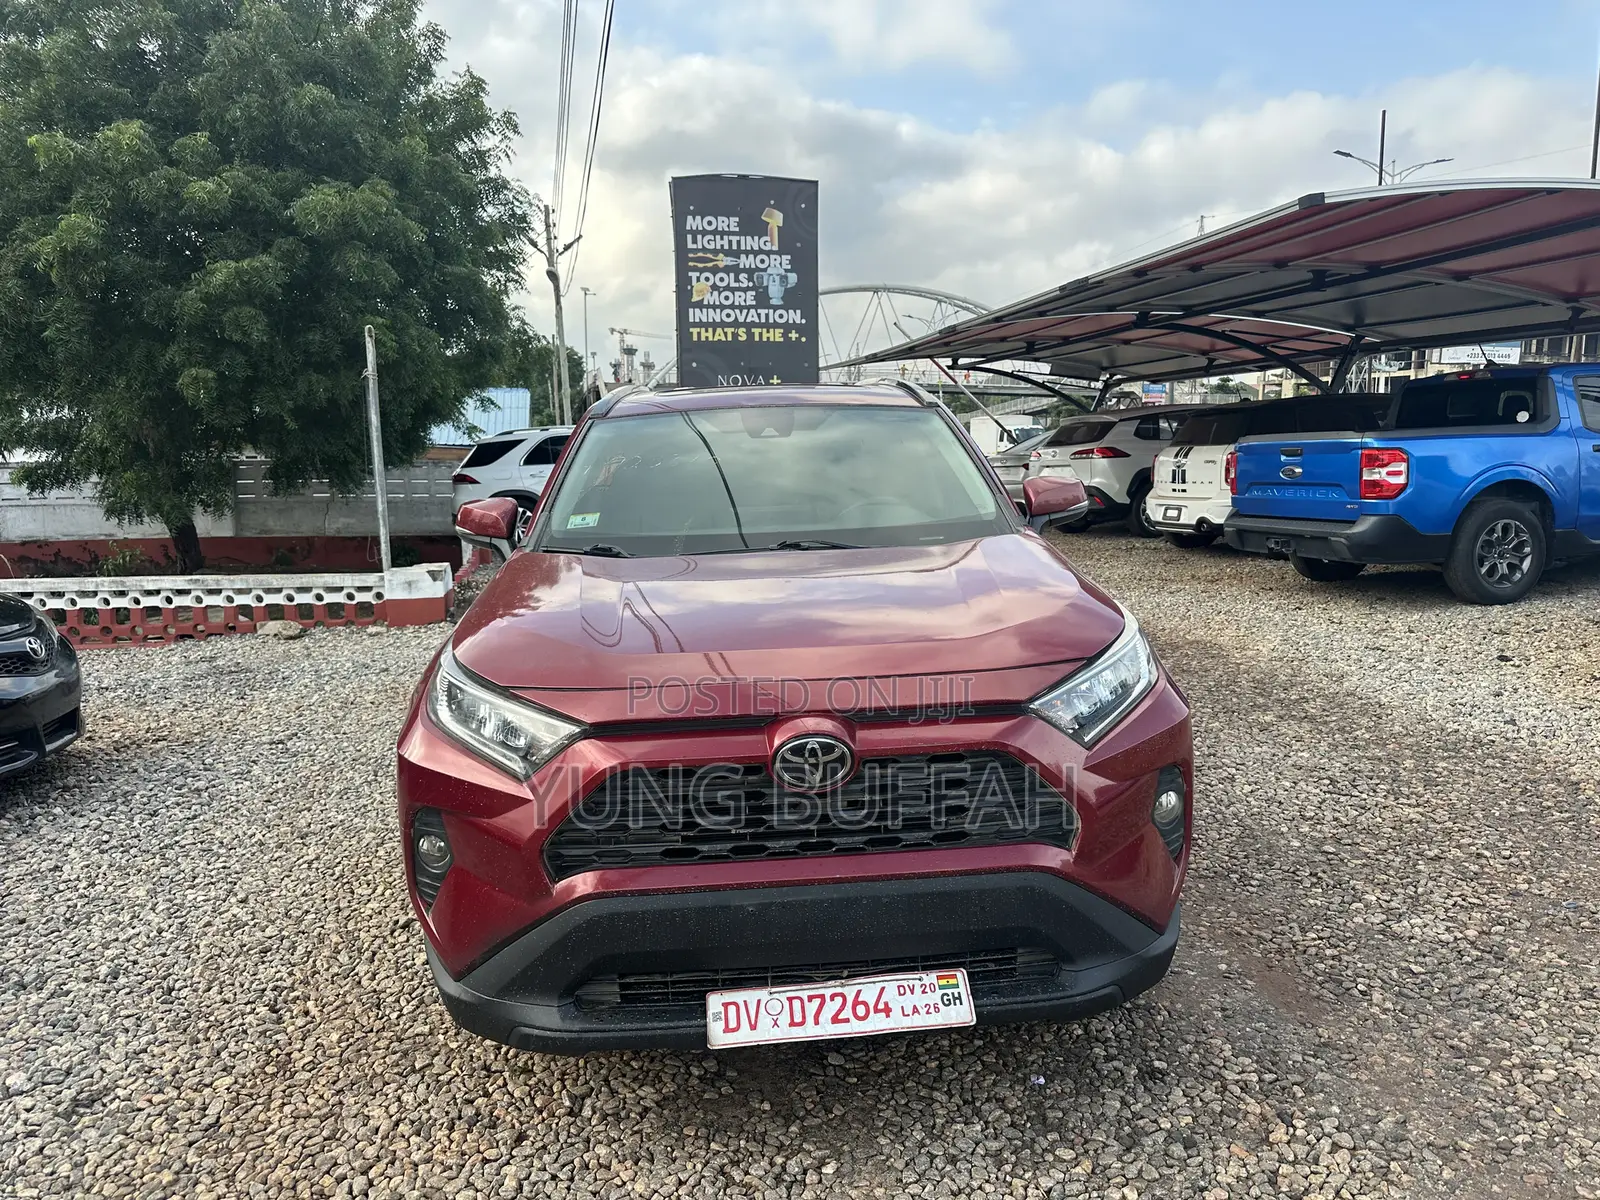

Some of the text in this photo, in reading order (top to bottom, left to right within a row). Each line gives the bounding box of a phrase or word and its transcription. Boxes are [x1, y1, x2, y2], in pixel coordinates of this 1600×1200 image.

[686, 216, 739, 231] MORE
[687, 235, 777, 250] LIGHTING.
[739, 254, 791, 269] MORE
[688, 272, 753, 287] TOOLS.
[703, 291, 756, 306] MORE
[688, 308, 806, 324] INNOVATION.
[689, 327, 747, 342] THAT'S
[751, 328, 784, 342] THE
[717, 374, 765, 387] NOVA
[1251, 488, 1340, 498] MAVERICK
[896, 982, 937, 997] DV 20
[940, 991, 964, 1008] GH
[721, 998, 761, 1034] DV
[786, 986, 893, 1028] D7264
[901, 1002, 941, 1018] LA 26
